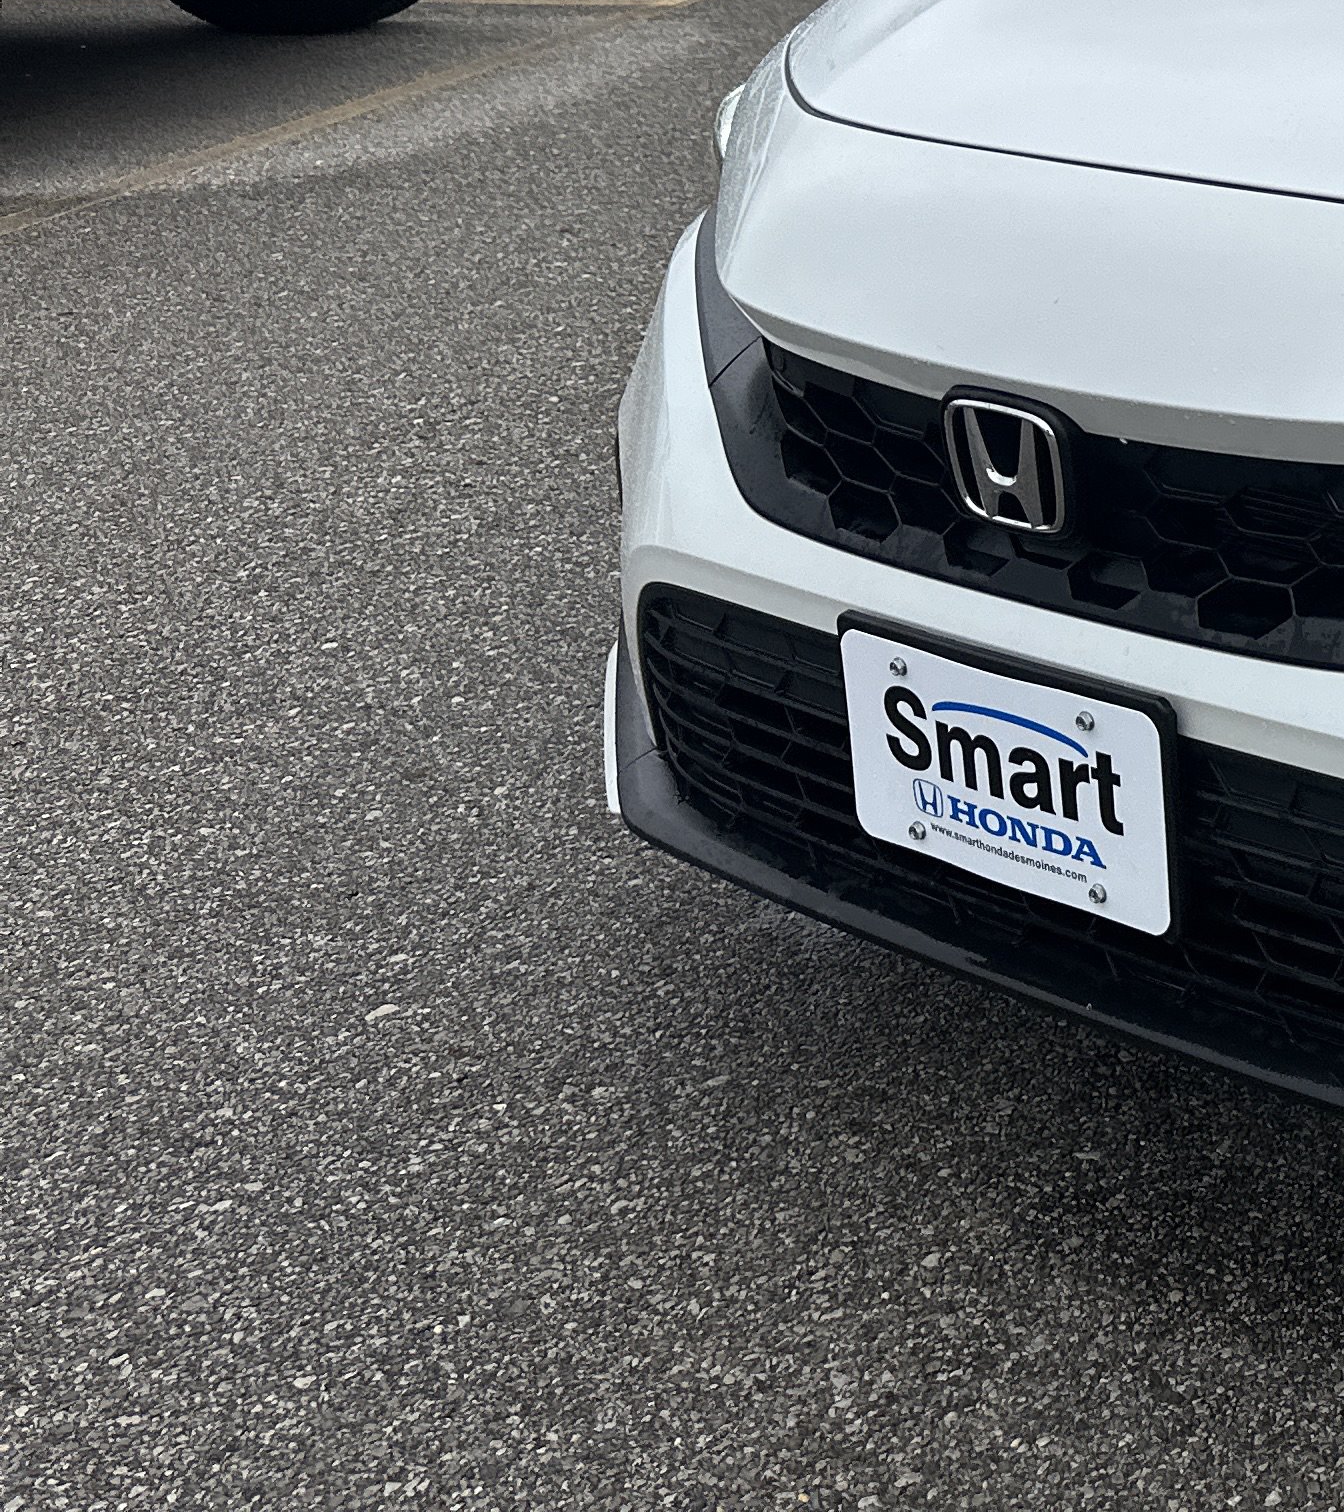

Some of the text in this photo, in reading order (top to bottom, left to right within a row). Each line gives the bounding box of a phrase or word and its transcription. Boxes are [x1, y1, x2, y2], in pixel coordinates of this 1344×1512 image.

[884, 685, 1125, 837] Smart
[930, 822, 1088, 883] www.smarthondadesmoines.com
[946, 794, 1107, 870] HONDA
